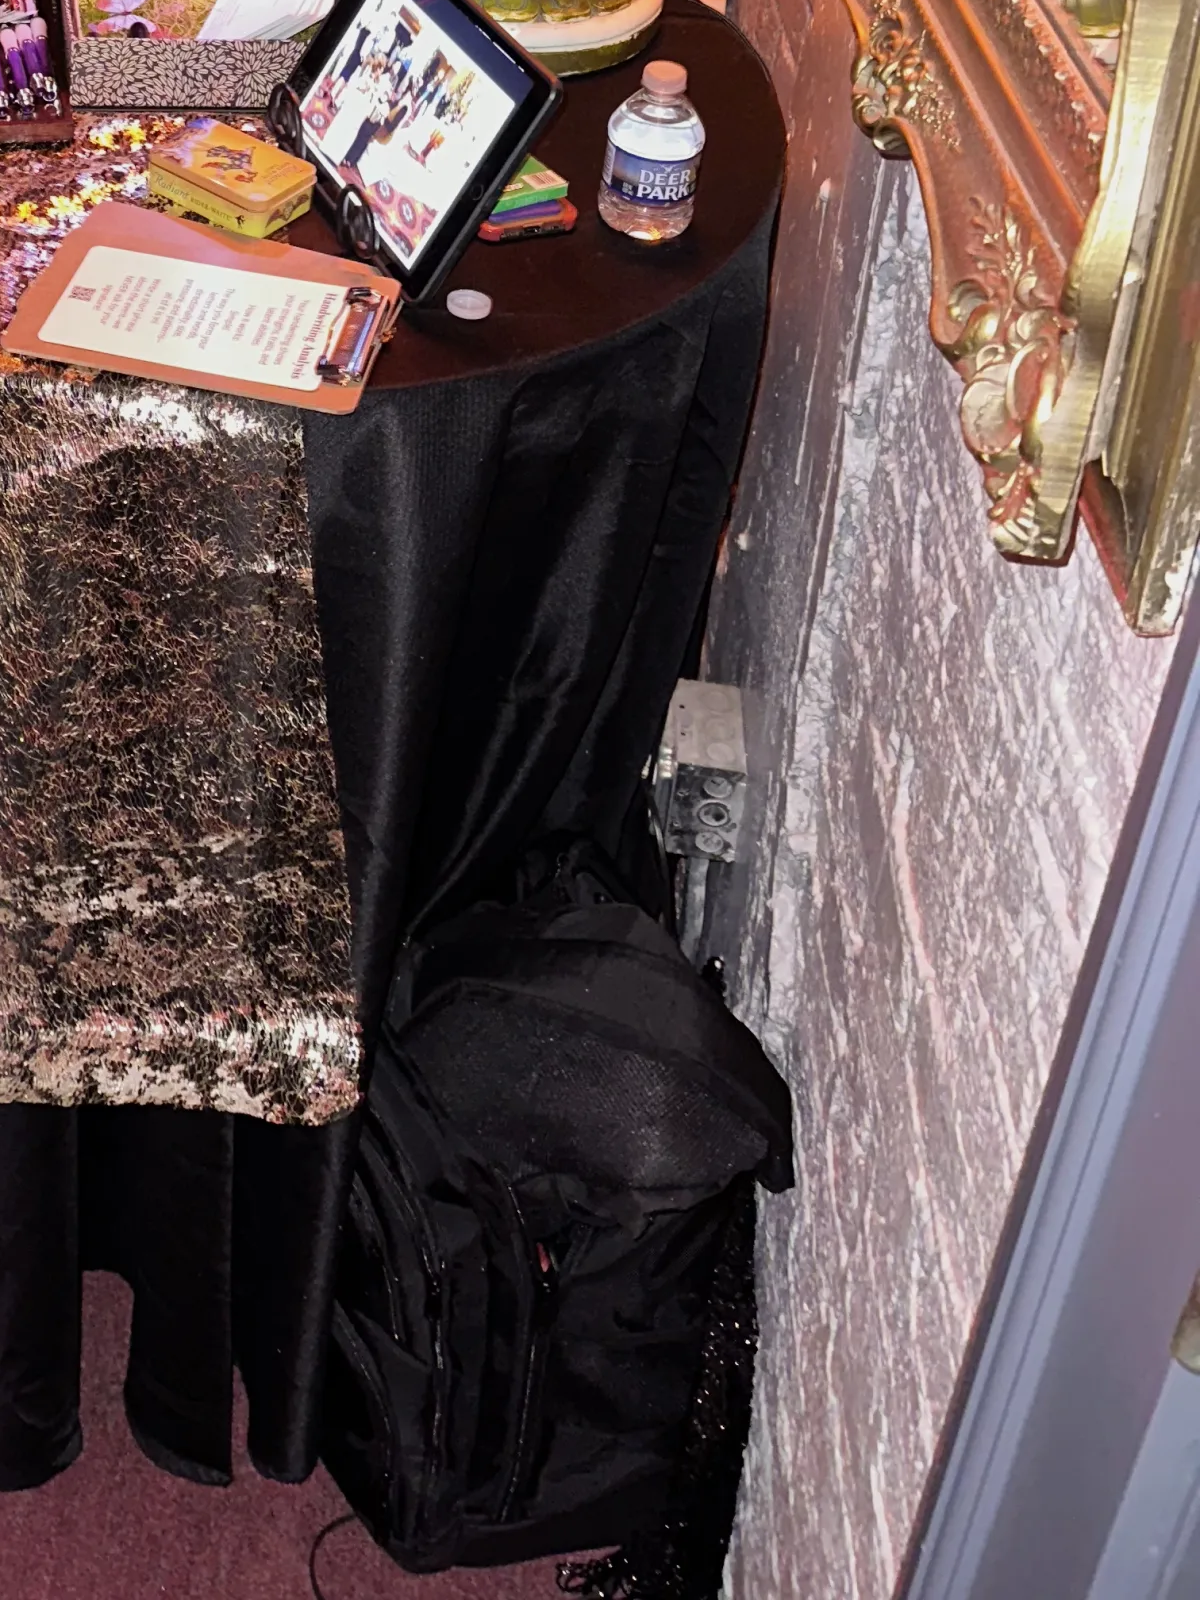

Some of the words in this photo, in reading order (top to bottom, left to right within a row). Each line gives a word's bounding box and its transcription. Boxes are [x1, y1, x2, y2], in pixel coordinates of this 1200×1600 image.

[154, 172, 190, 199] Radiant
[638, 169, 691, 186] DEER
[636, 182, 689, 201] PARK
[303, 293, 338, 343] Handwriting
[291, 344, 315, 379] Analysis
